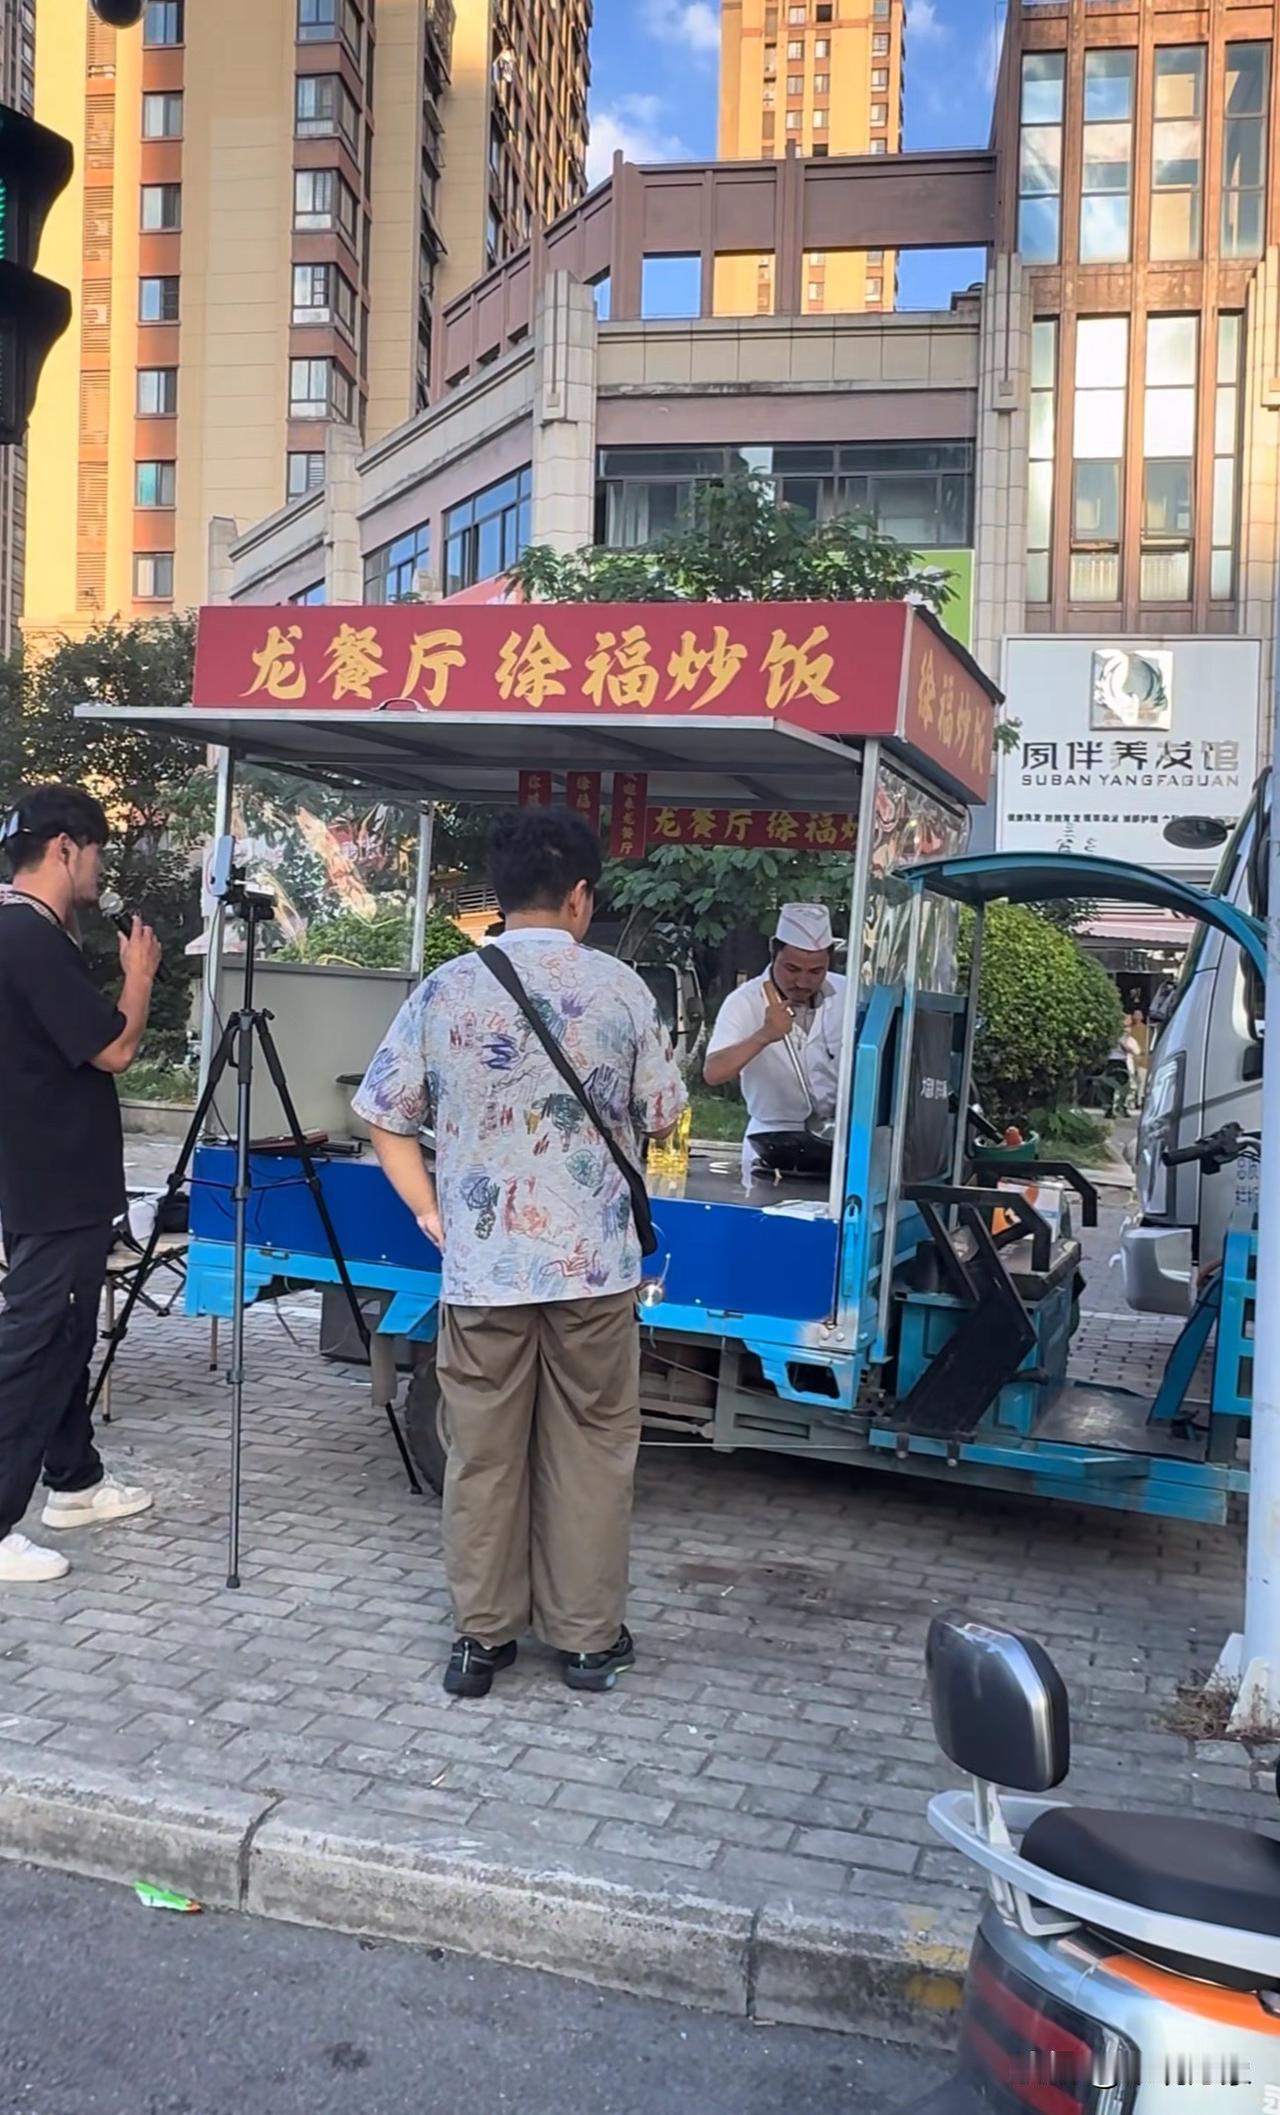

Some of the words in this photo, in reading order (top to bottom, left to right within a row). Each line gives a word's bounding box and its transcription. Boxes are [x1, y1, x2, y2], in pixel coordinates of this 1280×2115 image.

[240, 624, 467, 706] 龙餐厅
[495, 624, 841, 709] 徐福炒饭
[1021, 740, 1239, 771] 夙伴养发馆
[1021, 774, 1091, 787] SUBAN
[1099, 774, 1239, 787] YANGFAGUAN
[653, 808, 754, 842] 龙餐厅
